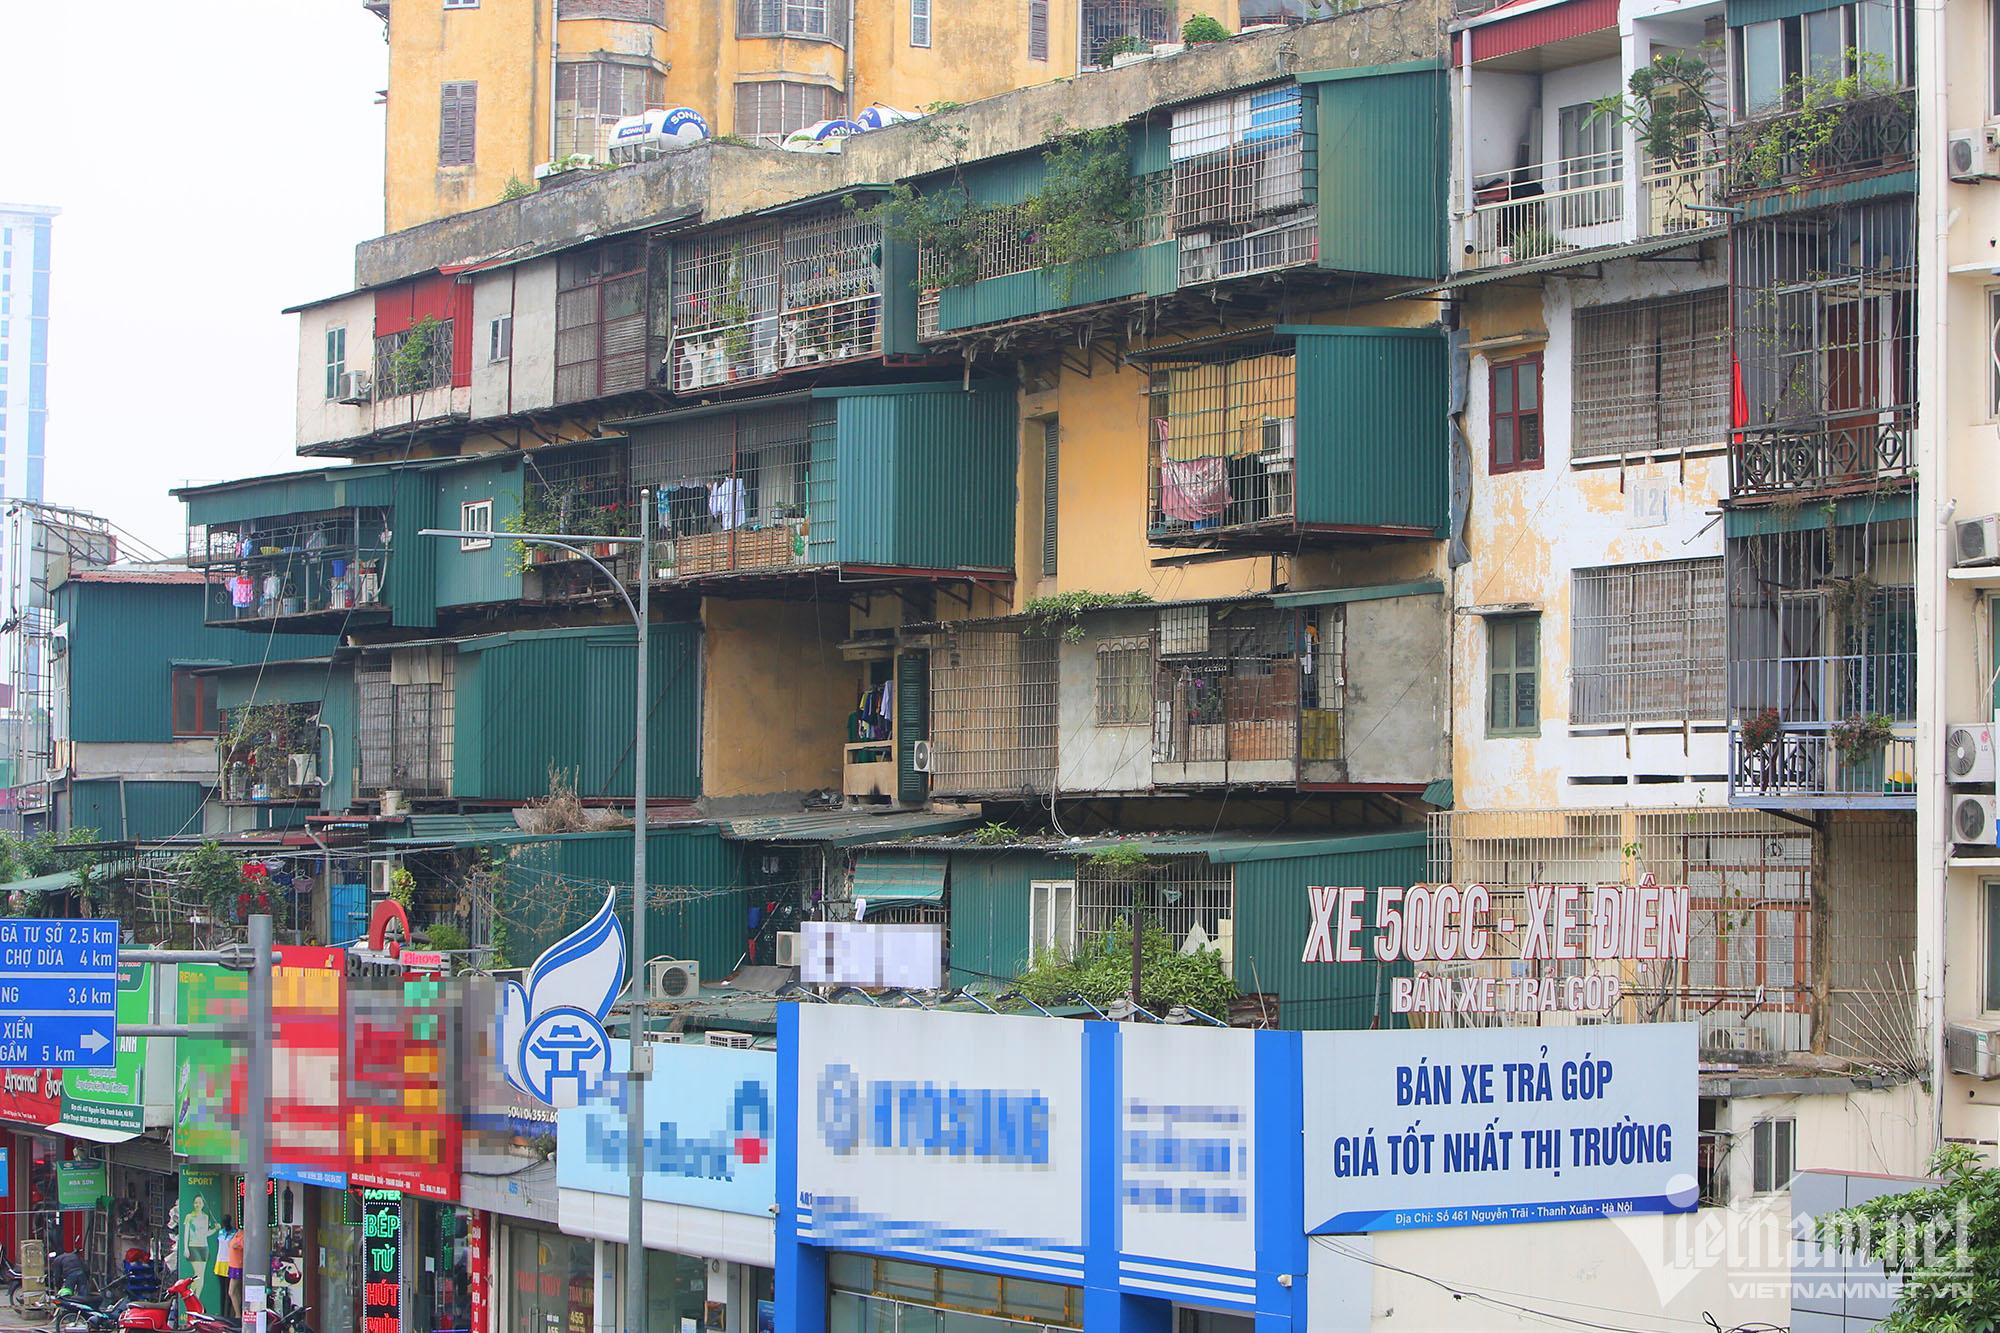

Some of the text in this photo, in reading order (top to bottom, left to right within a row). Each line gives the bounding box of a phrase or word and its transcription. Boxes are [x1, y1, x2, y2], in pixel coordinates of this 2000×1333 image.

[23, 926, 41, 943] TƯ
[45, 921, 64, 943] SỞ
[69, 927, 89, 945] 2,5
[93, 928, 113, 944] km
[1302, 885, 1367, 963] XE
[1373, 883, 1490, 963] 50CC
[1520, 886, 1583, 961] XE
[1592, 872, 1690, 974] ĐIỆN
[5, 945, 112, 968] CHỢ DỪA 4 km
[1, 986, 111, 1005] NG 3,6 km
[1391, 966, 1622, 1014] BÁN XE TRẢ GÓP
[3, 1016, 33, 1039] XIỂN
[0, 1040, 75, 1061] GẦM 5 km
[1396, 1045, 1614, 1107] BÁN XE TRẢ GÓP
[1333, 1115, 1672, 1179] GIÁ TỐT NHẤT THỊ TRƯỜNG
[364, 1188, 402, 1201] FASTER
[365, 1207, 400, 1238] BẾP
[1395, 1213, 1412, 1226] Địa
[1436, 1209, 1449, 1222] Số
[1451, 1210, 1468, 1221] 461
[1471, 1207, 1508, 1222] Nguyễn
[1510, 1207, 1529, 1218] Trãi
[1536, 1205, 1567, 1217] Thanh
[1569, 1204, 1593, 1215] Xuân
[1601, 1202, 1614, 1213] Hà
[1616, 1200, 1633, 1215] Nội
[371, 1243, 396, 1273] TỪ
[366, 1279, 400, 1307] HÚT
